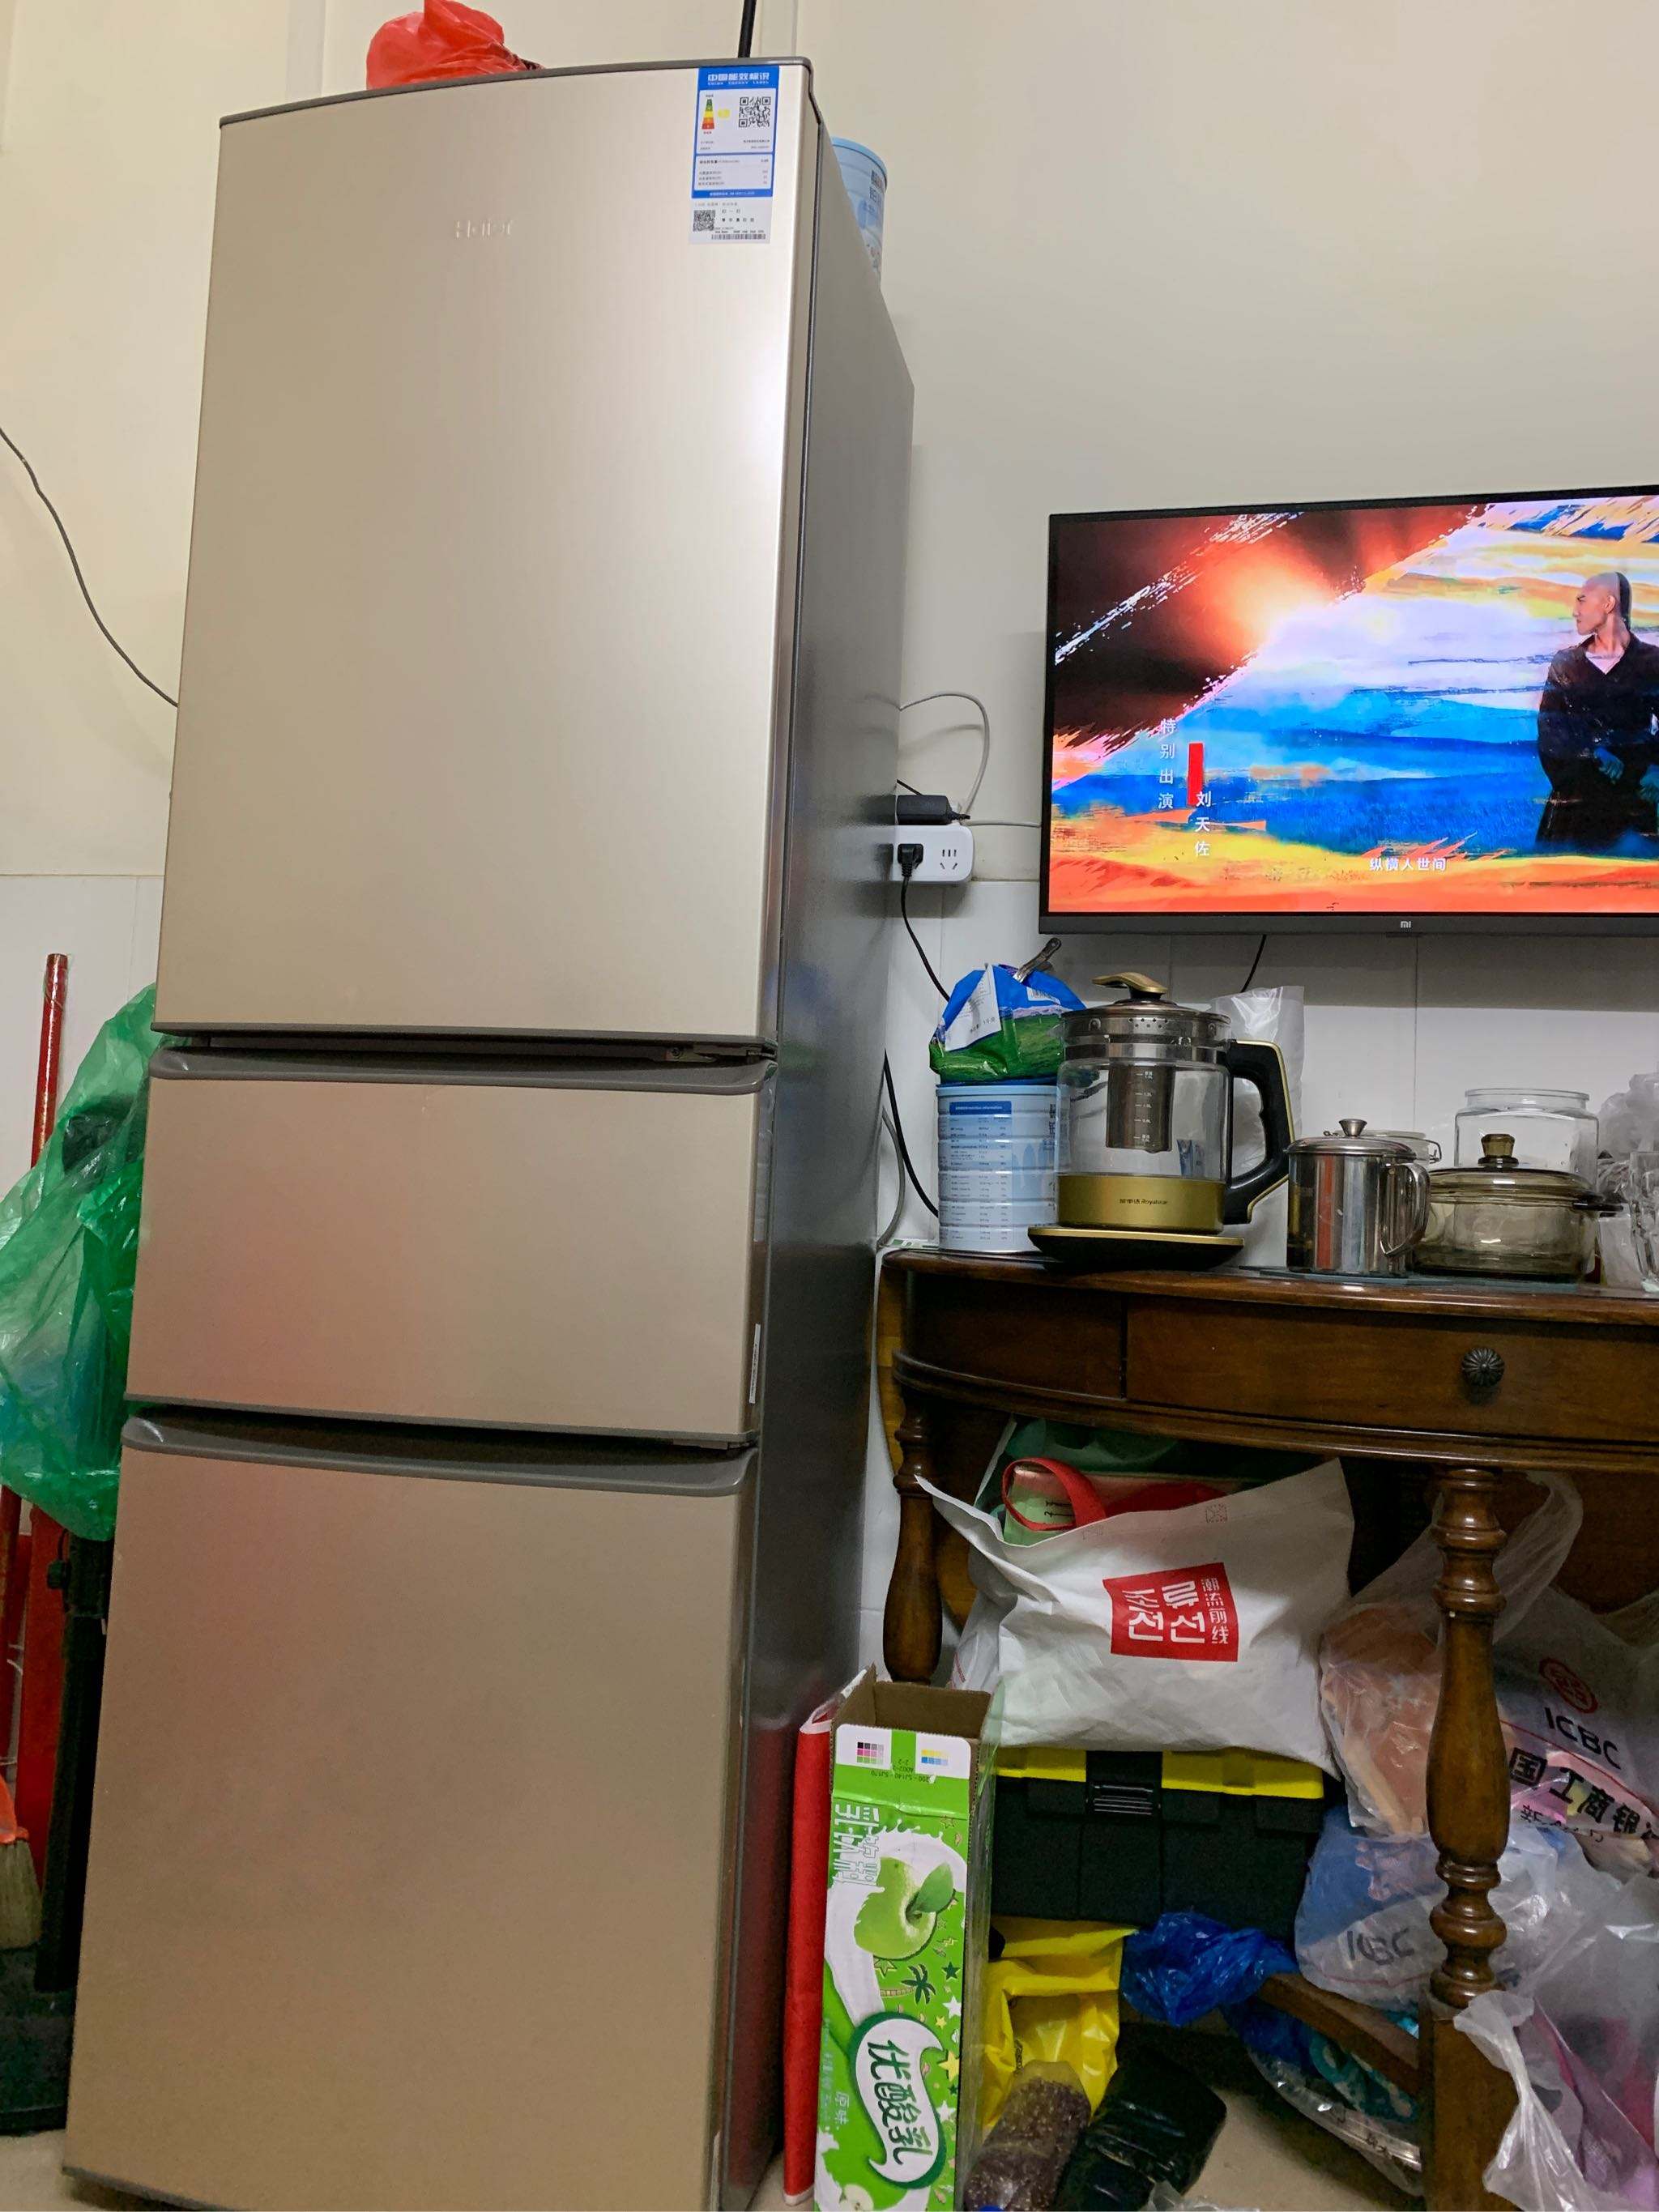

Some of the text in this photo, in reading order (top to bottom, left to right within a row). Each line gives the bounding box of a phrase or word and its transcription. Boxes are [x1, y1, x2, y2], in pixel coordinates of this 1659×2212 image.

[707, 72, 770, 82] 中国能效标识
[1158, 718, 1176, 809] 特别出演
[1194, 791, 1212, 857] 刘天佐
[1369, 857, 1447, 872] 纵横人世间
[1201, 1577, 1230, 1645] 潮流前线
[1544, 1707, 1622, 1771] ICBC
[866, 2039, 934, 2165] 优酸乳
